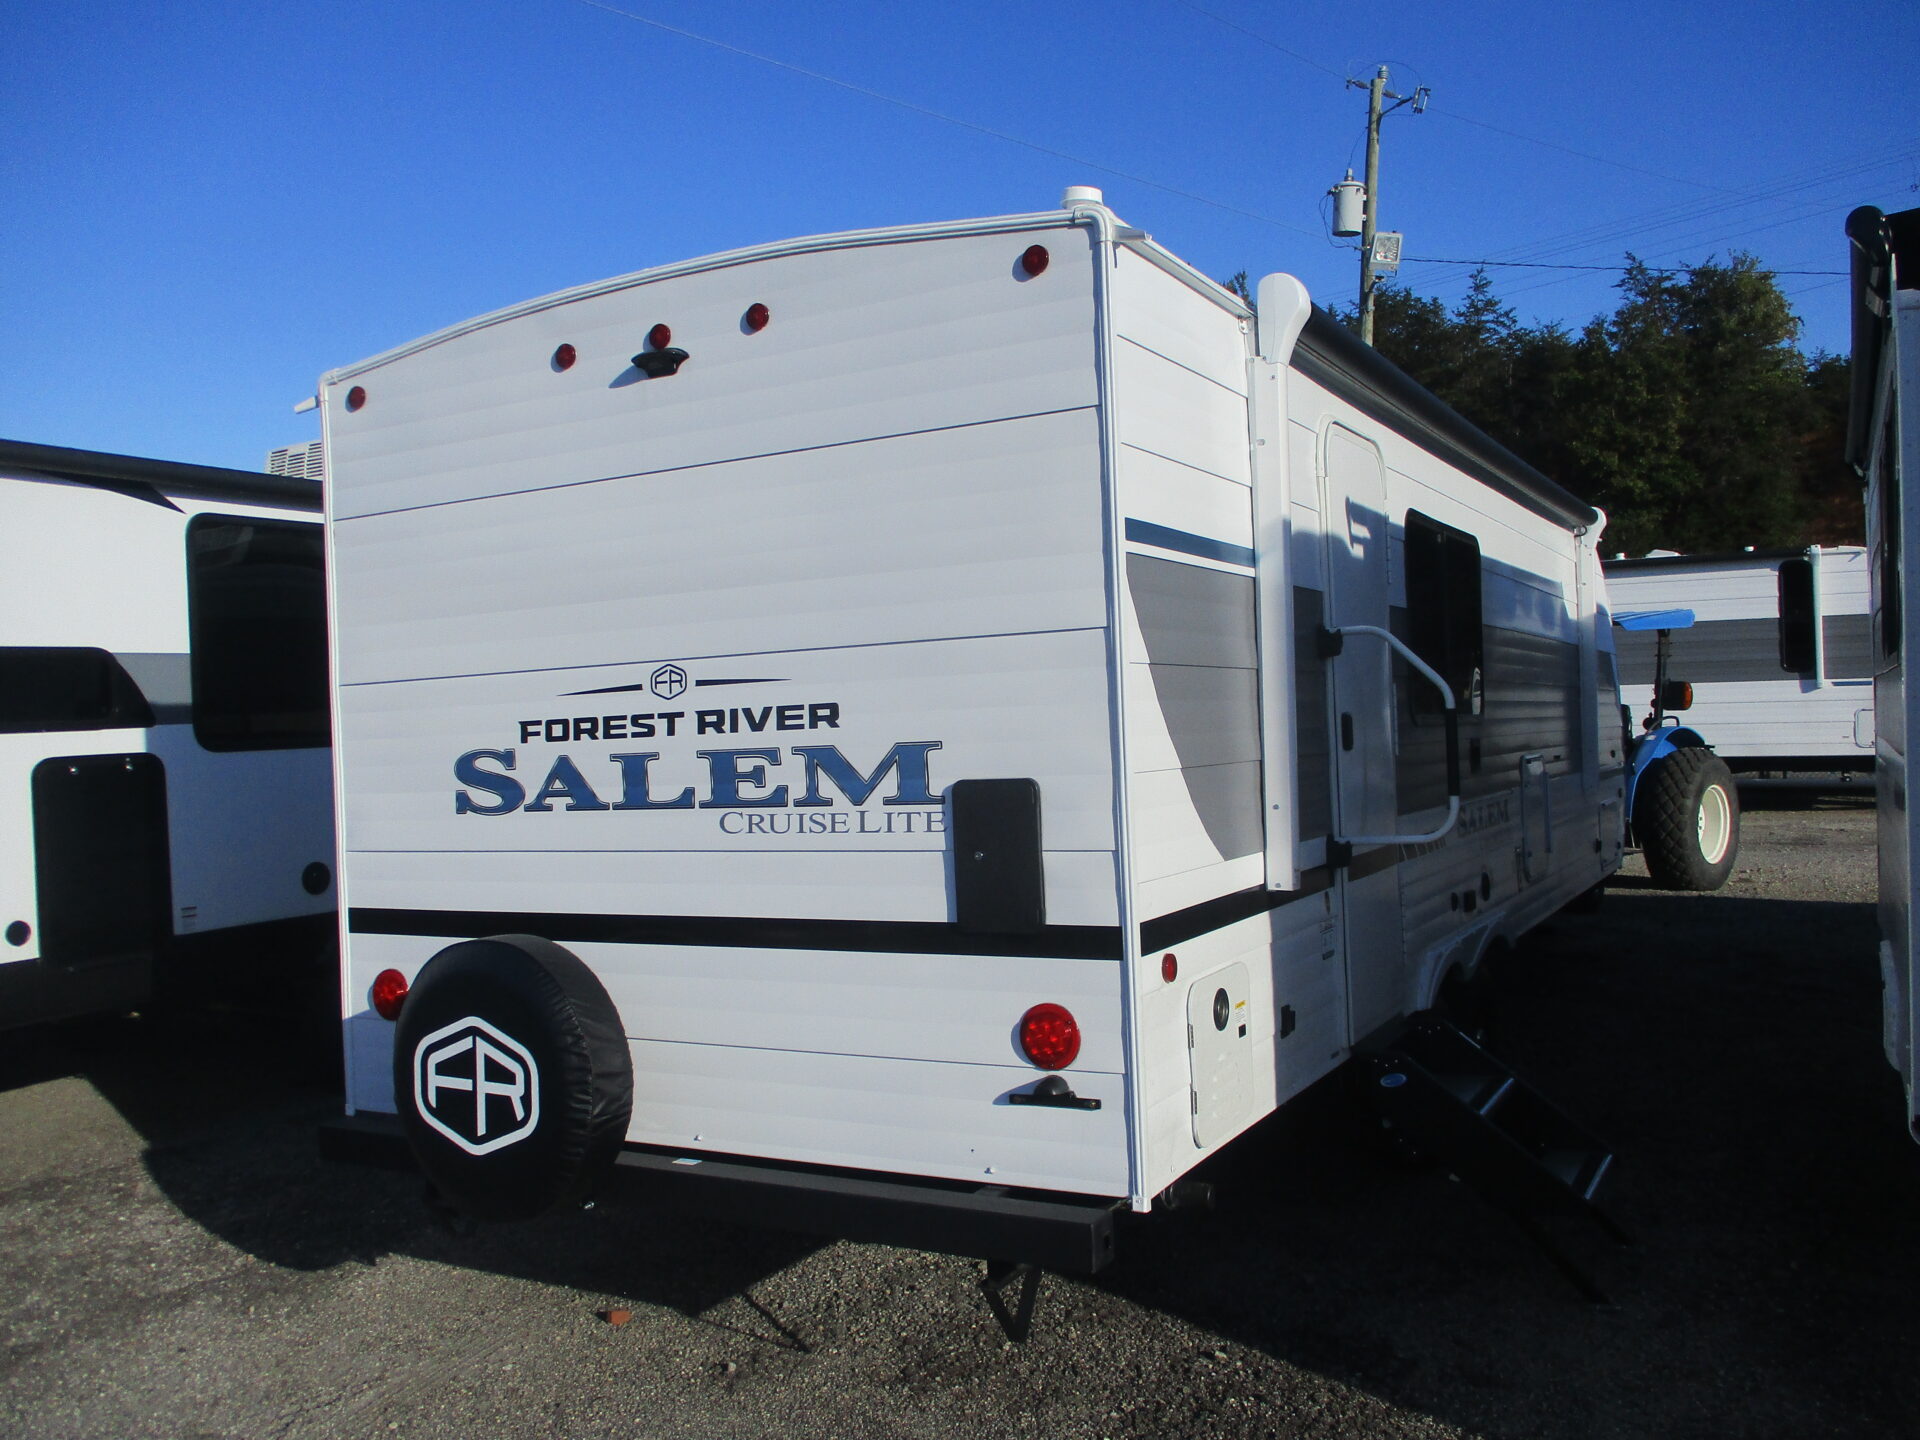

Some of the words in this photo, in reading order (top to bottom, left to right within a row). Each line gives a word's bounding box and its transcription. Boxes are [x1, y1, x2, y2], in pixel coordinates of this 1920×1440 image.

[653, 667, 684, 696] FR
[518, 711, 685, 744] FOREST
[695, 702, 840, 735] RIVER
[454, 740, 946, 817] SALEM
[1458, 799, 1510, 836] SALEM
[426, 1034, 526, 1138] FR
